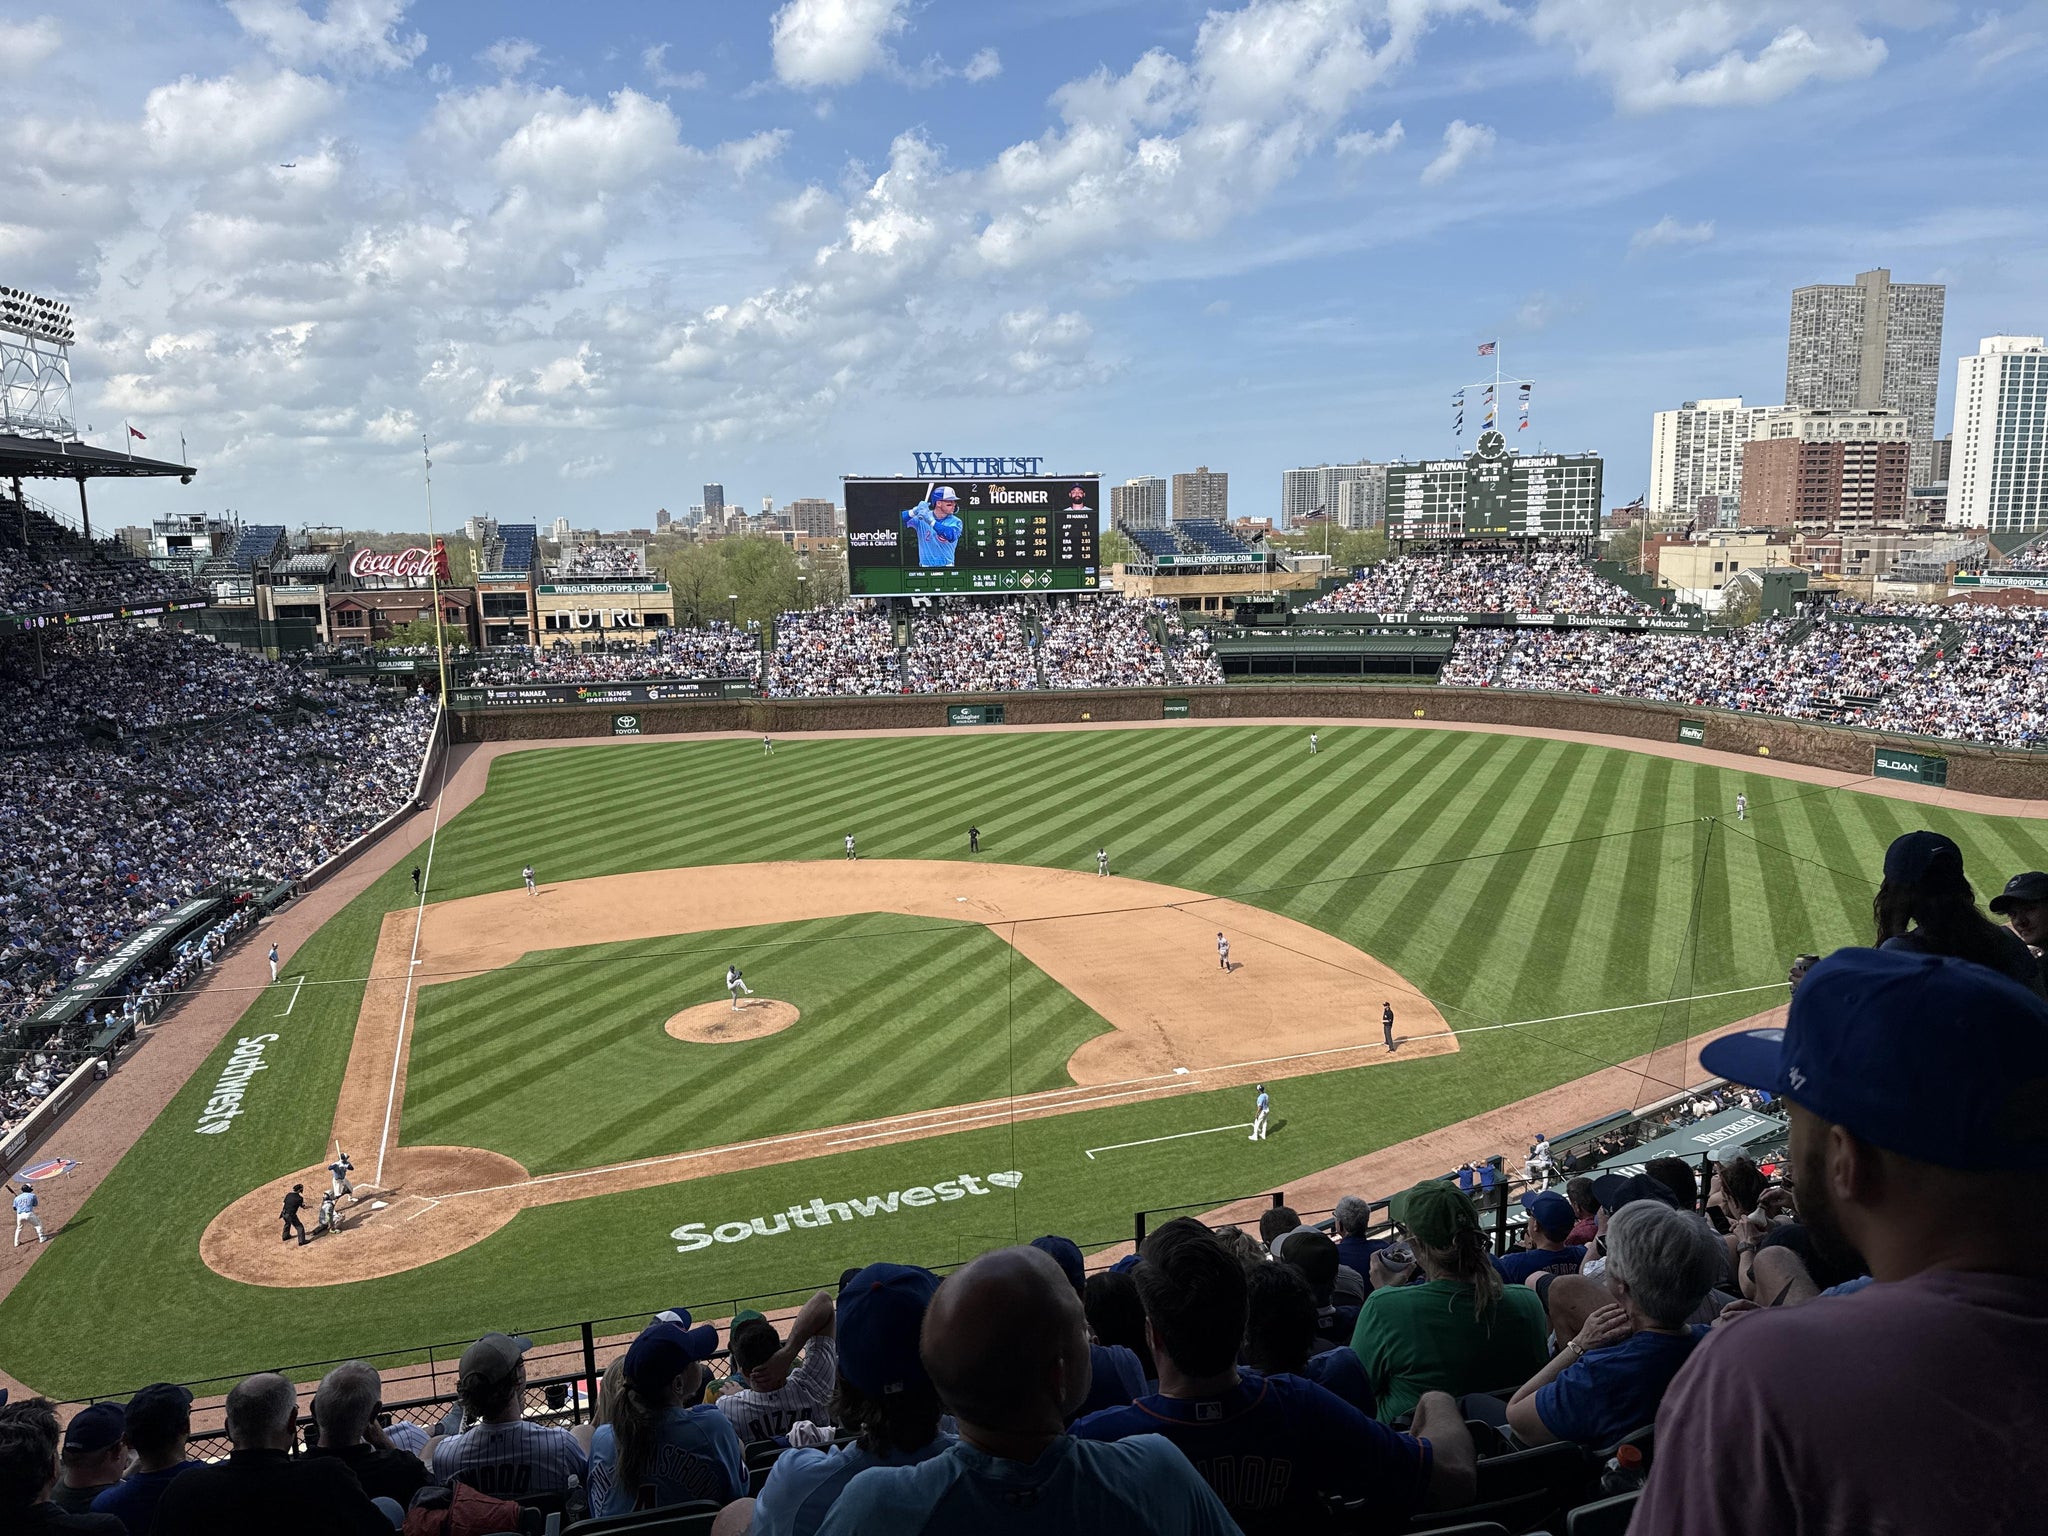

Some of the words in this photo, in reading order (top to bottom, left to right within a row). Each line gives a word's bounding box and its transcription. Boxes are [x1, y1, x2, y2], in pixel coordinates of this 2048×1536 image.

[912, 452, 1043, 475] WINTRUST
[1426, 462, 1468, 472] NATIONAL
[1512, 458, 1558, 468] AMERICAN
[972, 484, 978, 492] 2
[988, 484, 1006, 494] Nico
[1490, 482, 1496, 491] 2
[990, 490, 1048, 504] HOERNER
[850, 529, 898, 540] wendella
[350, 548, 442, 577] Coca-Cola
[1173, 554, 1252, 564] WRIGLEYROOFTOPS.COM
[1085, 577, 1095, 585] 20
[554, 584, 653, 592] WRIGLEYROOFTOPS.COM
[1377, 614, 1408, 623] YETI
[1425, 615, 1468, 623] tastytrade
[1650, 619, 1689, 628] Advocate
[578, 690, 632, 699] DRAFTKINGS
[1682, 728, 1702, 739] Hefty
[118, 927, 166, 957] CHICAGO
[86, 957, 129, 980] CUBS
[198, 1034, 279, 1123] Southwest
[1691, 1115, 1761, 1144] WINTRUST
[669, 1174, 990, 1254] Southwest
